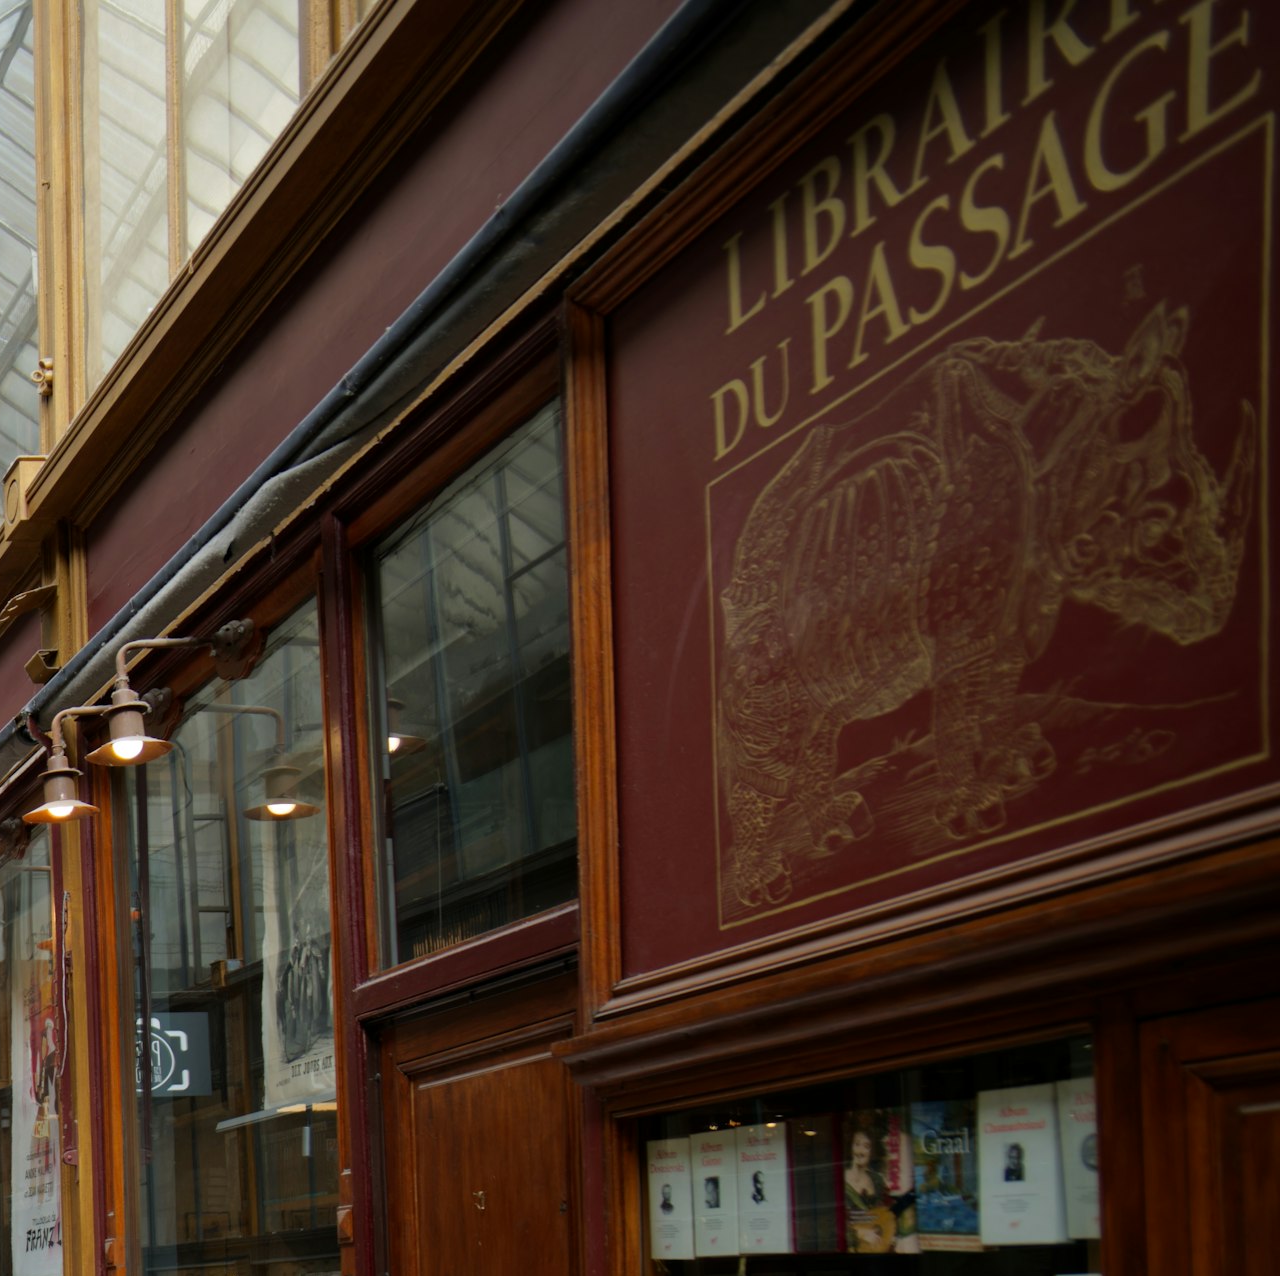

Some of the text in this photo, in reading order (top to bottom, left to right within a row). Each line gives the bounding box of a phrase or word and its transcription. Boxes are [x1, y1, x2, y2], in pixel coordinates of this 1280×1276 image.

[710, 0, 1262, 462] DU PASSAGE
[921, 1127, 971, 1155] Graal
